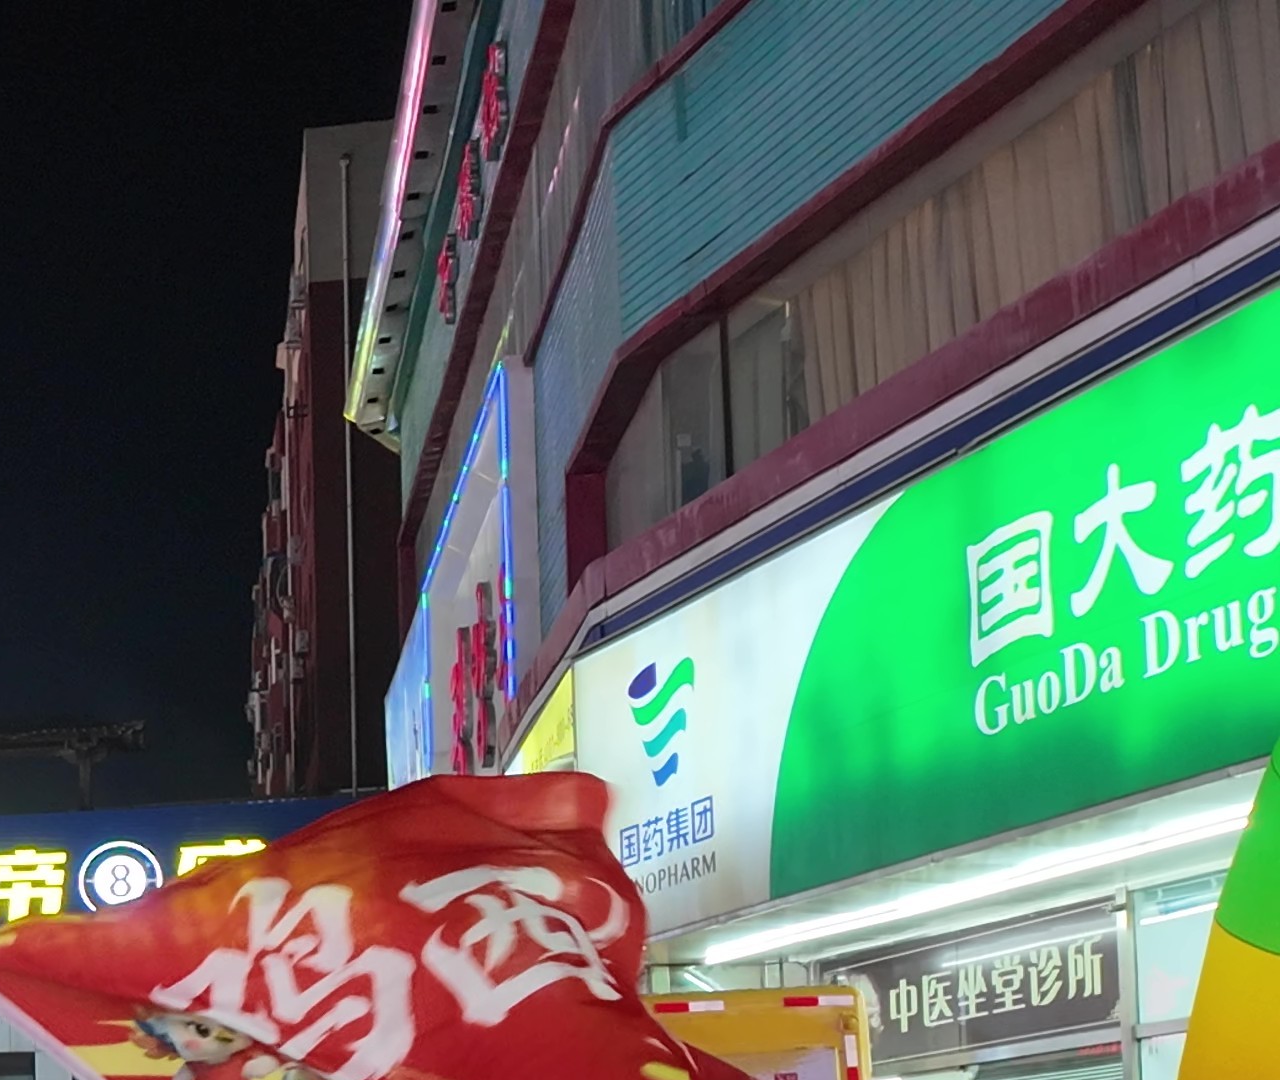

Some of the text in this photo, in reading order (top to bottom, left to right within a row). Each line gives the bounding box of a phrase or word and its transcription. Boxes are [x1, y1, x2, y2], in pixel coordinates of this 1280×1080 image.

[966, 404, 1280, 668] 国大药
[974, 587, 1279, 735] GuoDa Drug
[619, 795, 714, 869] 国药集团
[634, 851, 717, 895] NOPHARM
[889, 935, 1104, 1034] 中医坐堂诊所
